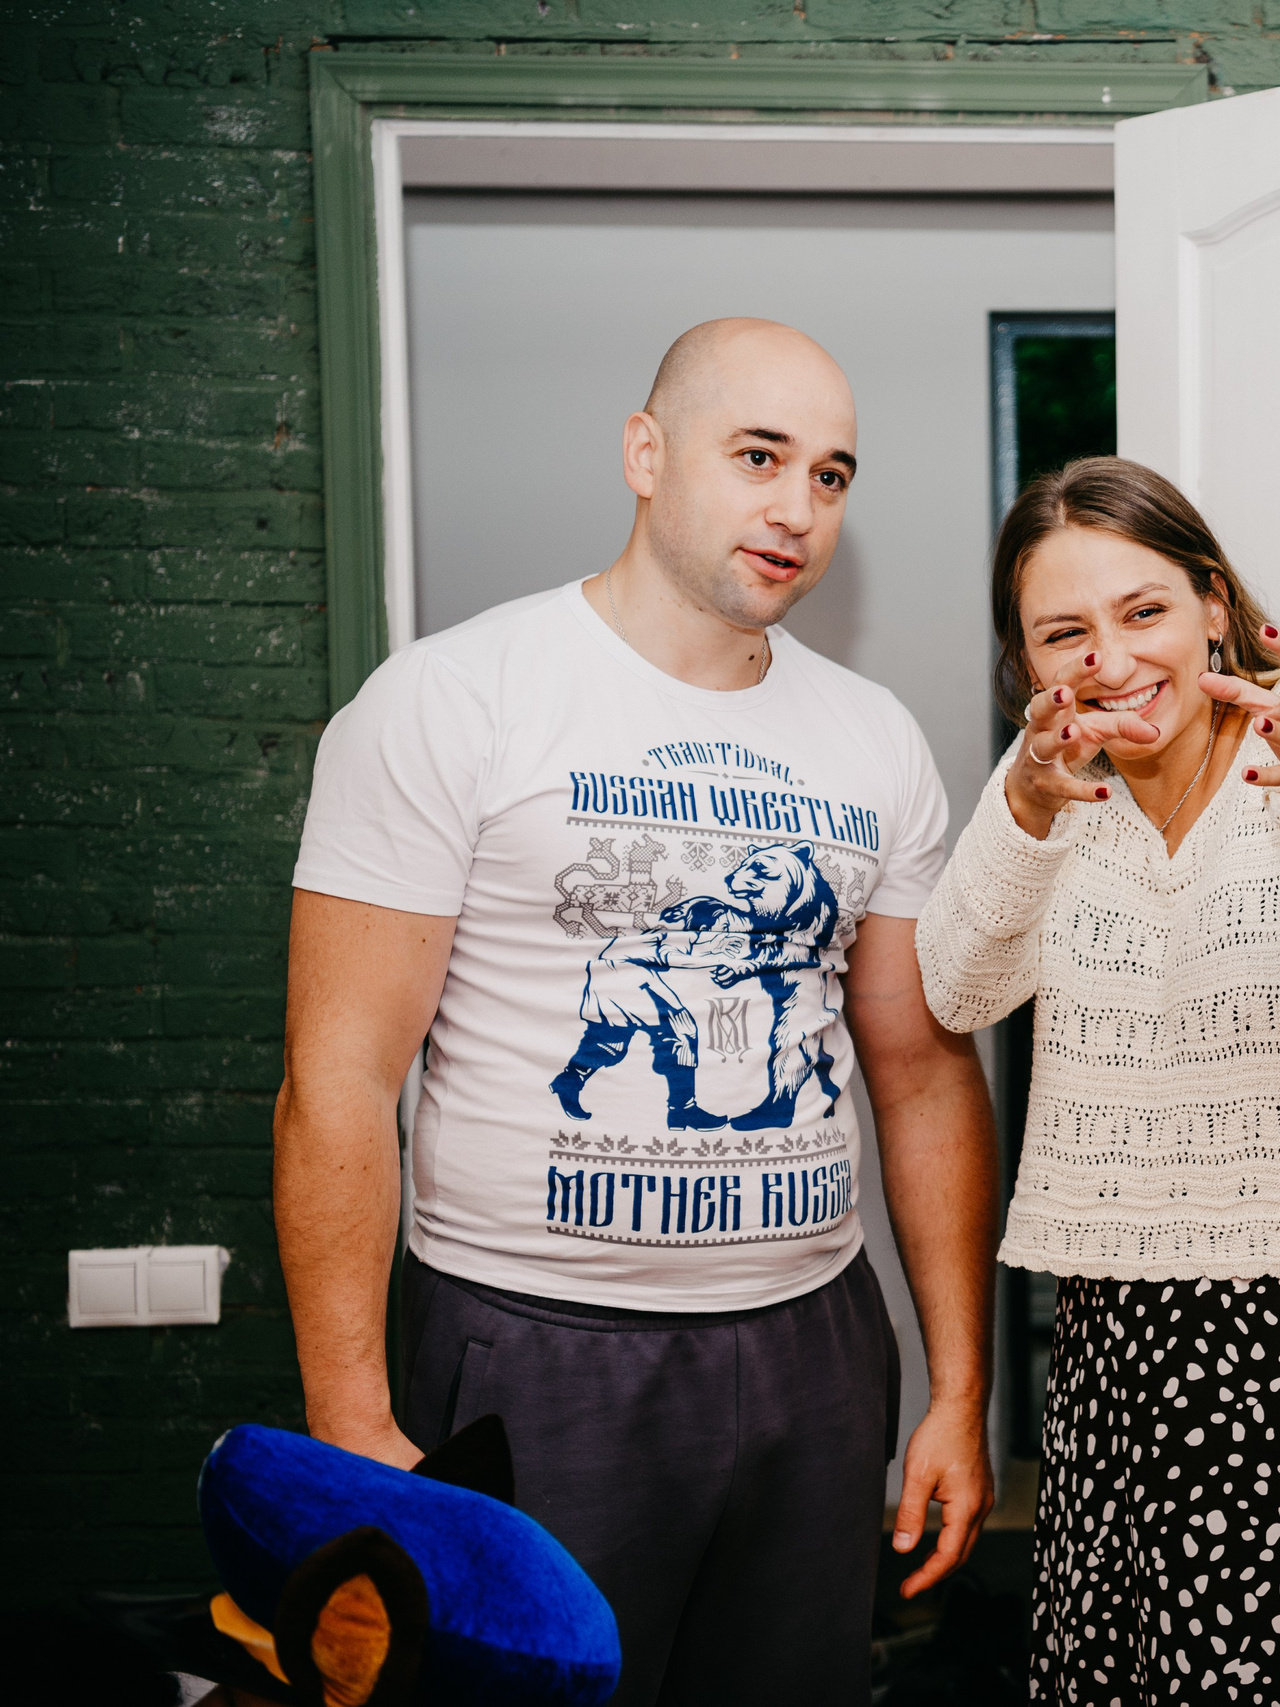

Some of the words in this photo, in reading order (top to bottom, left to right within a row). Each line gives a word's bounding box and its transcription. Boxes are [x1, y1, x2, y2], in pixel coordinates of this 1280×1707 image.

[569, 771, 698, 823] RUSSIAN
[709, 785, 879, 851] WRESTLING
[546, 1165, 741, 1235] MOTHER
